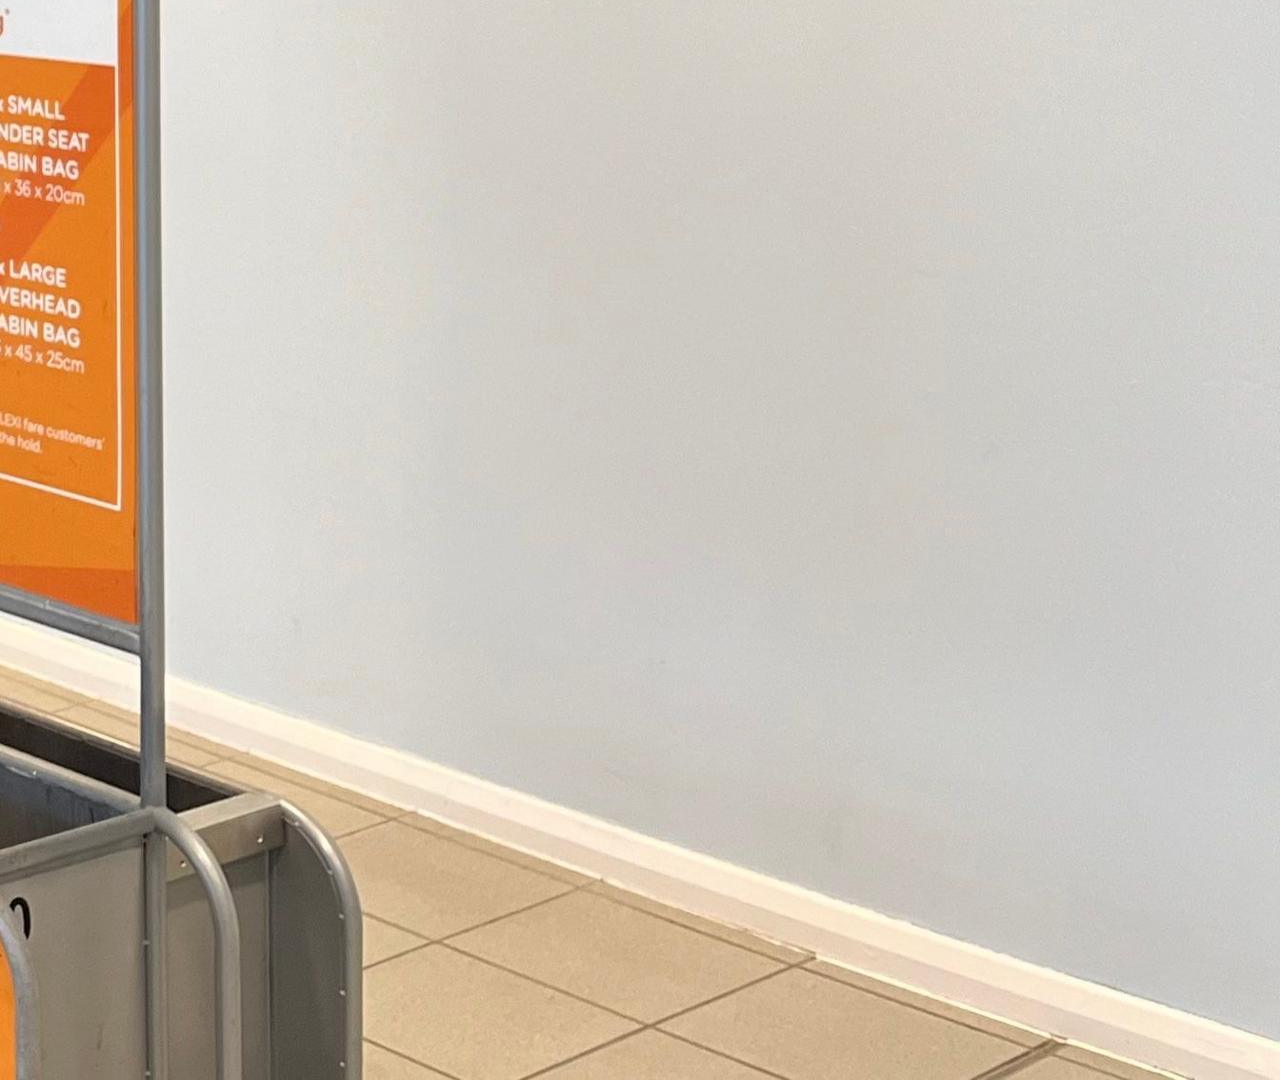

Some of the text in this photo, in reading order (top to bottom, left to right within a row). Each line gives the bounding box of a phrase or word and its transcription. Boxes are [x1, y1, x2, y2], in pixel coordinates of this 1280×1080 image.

[7, 95, 65, 120] SMALL
[48, 129, 89, 152] SEAT
[42, 157, 79, 180] BAG
[3, 181, 12, 194] x
[14, 178, 32, 197] 36
[35, 185, 43, 199] x
[45, 183, 86, 206] 20cm
[9, 258, 67, 288] LARGE
[43, 321, 80, 348] BAG
[4, 344, 12, 358] x
[15, 341, 33, 362] 45
[35, 352, 44, 366] x
[46, 348, 85, 374] 25cm
[23, 417, 44, 436] fare
